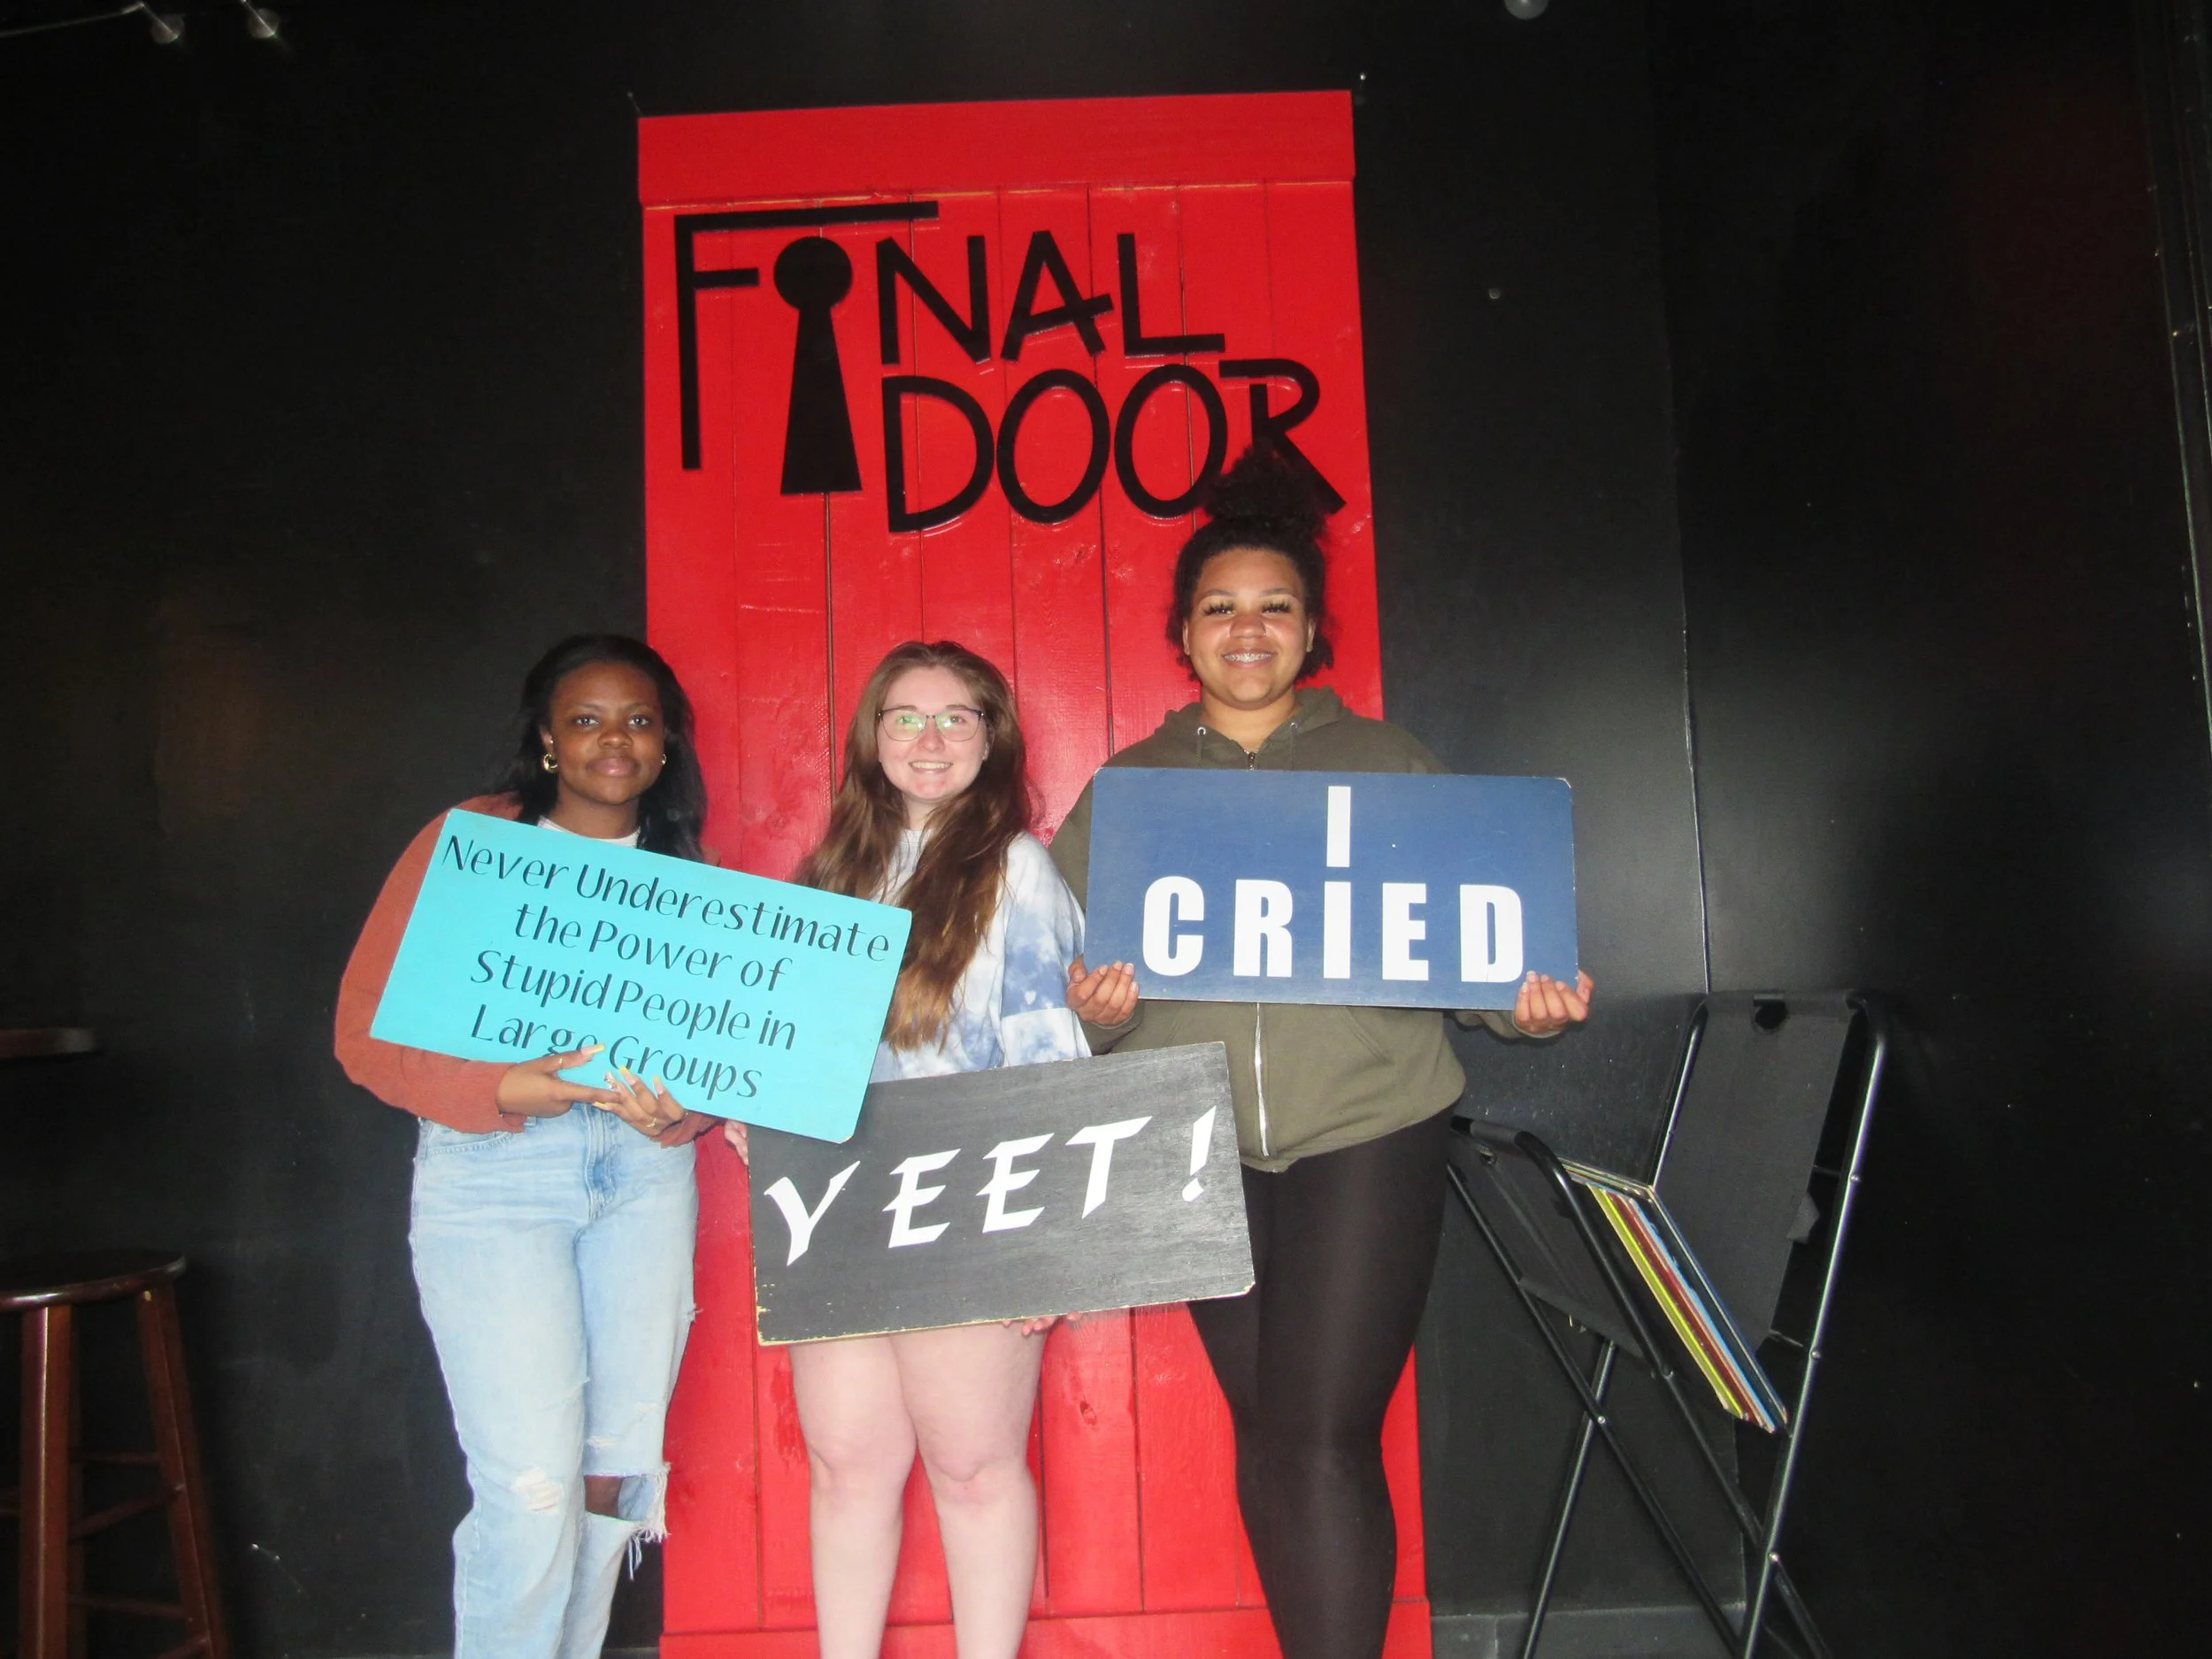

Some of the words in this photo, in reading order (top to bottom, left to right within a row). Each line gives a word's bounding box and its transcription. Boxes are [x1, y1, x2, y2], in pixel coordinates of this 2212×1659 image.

[881, 359, 1347, 533] DOOR
[1326, 786, 1352, 868] I
[442, 834, 569, 890] Never
[576, 864, 890, 962] Underestimate
[515, 903, 582, 949] the
[588, 919, 733, 979] Power
[741, 956, 793, 991] of
[1142, 876, 1524, 983] CRIED
[471, 949, 612, 1010] Stupid
[615, 979, 751, 1040] People
[758, 1010, 797, 1050] in
[609, 1035, 763, 1101] Groups
